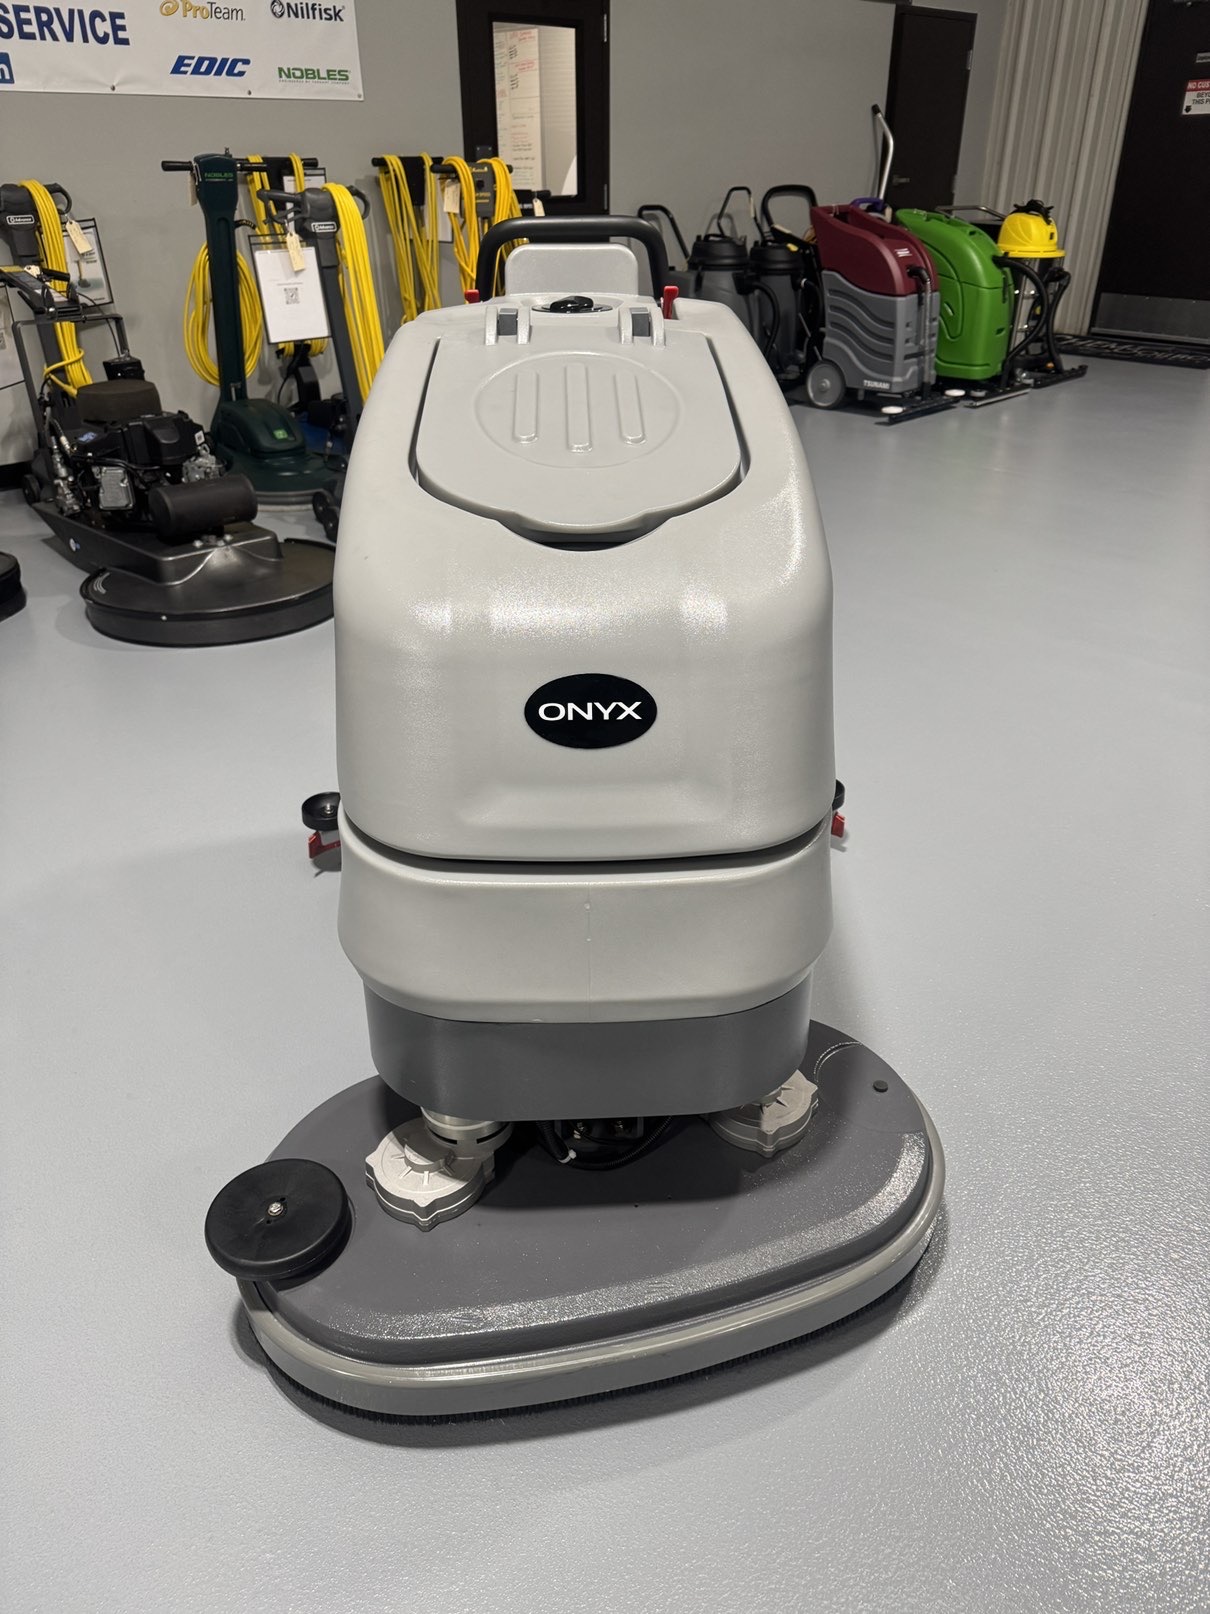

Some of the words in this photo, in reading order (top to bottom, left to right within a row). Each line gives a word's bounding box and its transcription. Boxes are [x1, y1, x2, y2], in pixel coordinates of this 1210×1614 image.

[182, 0, 245, 21] ProTeam
[286, 2, 344, 22] Nilfisk
[0, 3, 131, 46] SERVICE
[170, 55, 251, 77] EDIC
[277, 66, 350, 81] NOBLES
[1187, 81, 1197, 90] NO
[538, 701, 642, 721] ONYX
